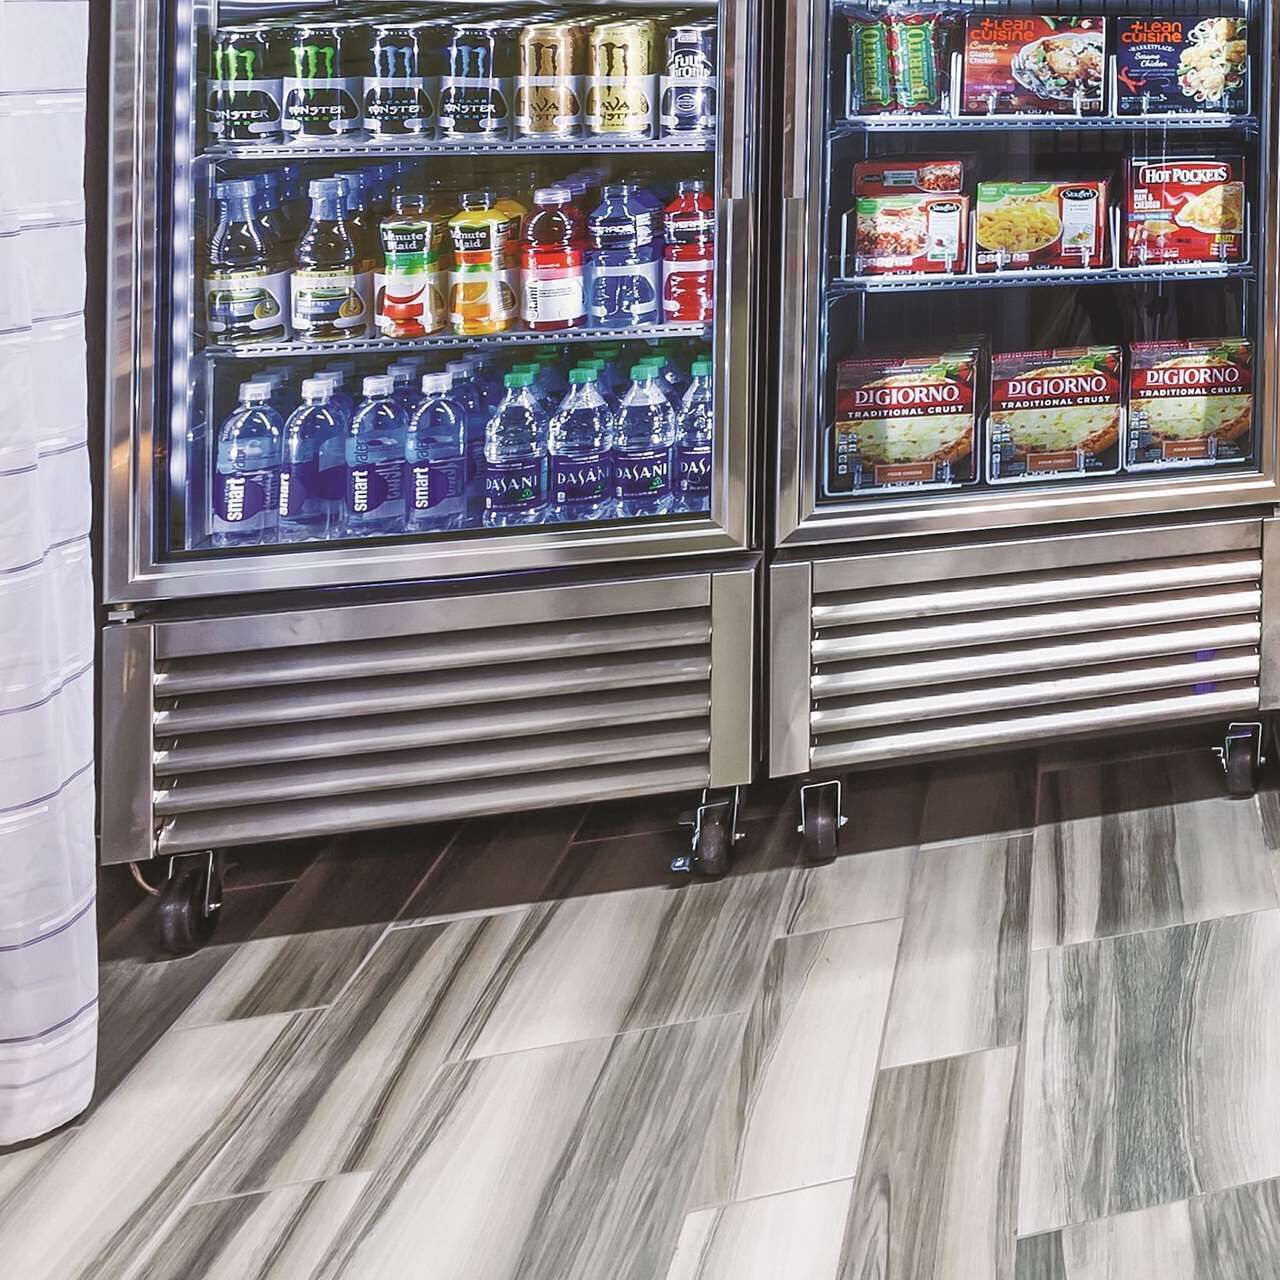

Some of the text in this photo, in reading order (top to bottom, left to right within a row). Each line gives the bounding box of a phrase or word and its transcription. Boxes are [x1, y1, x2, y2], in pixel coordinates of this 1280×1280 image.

[1145, 167, 1228, 184] HOT POCKETS
[383, 230, 424, 242] Minute
[387, 239, 418, 252] Maid
[1139, 385, 1243, 398] TRADITIONAL CRUST
[1001, 395, 1111, 410] TRADITIONAL CRUST
[848, 405, 964, 419] TRADITIONAL CRUST
[680, 460, 712, 480] DASA
[279, 472, 290, 517] smart
[353, 470, 369, 513] smart
[415, 467, 429, 509] smart
[226, 476, 246, 522] smart
